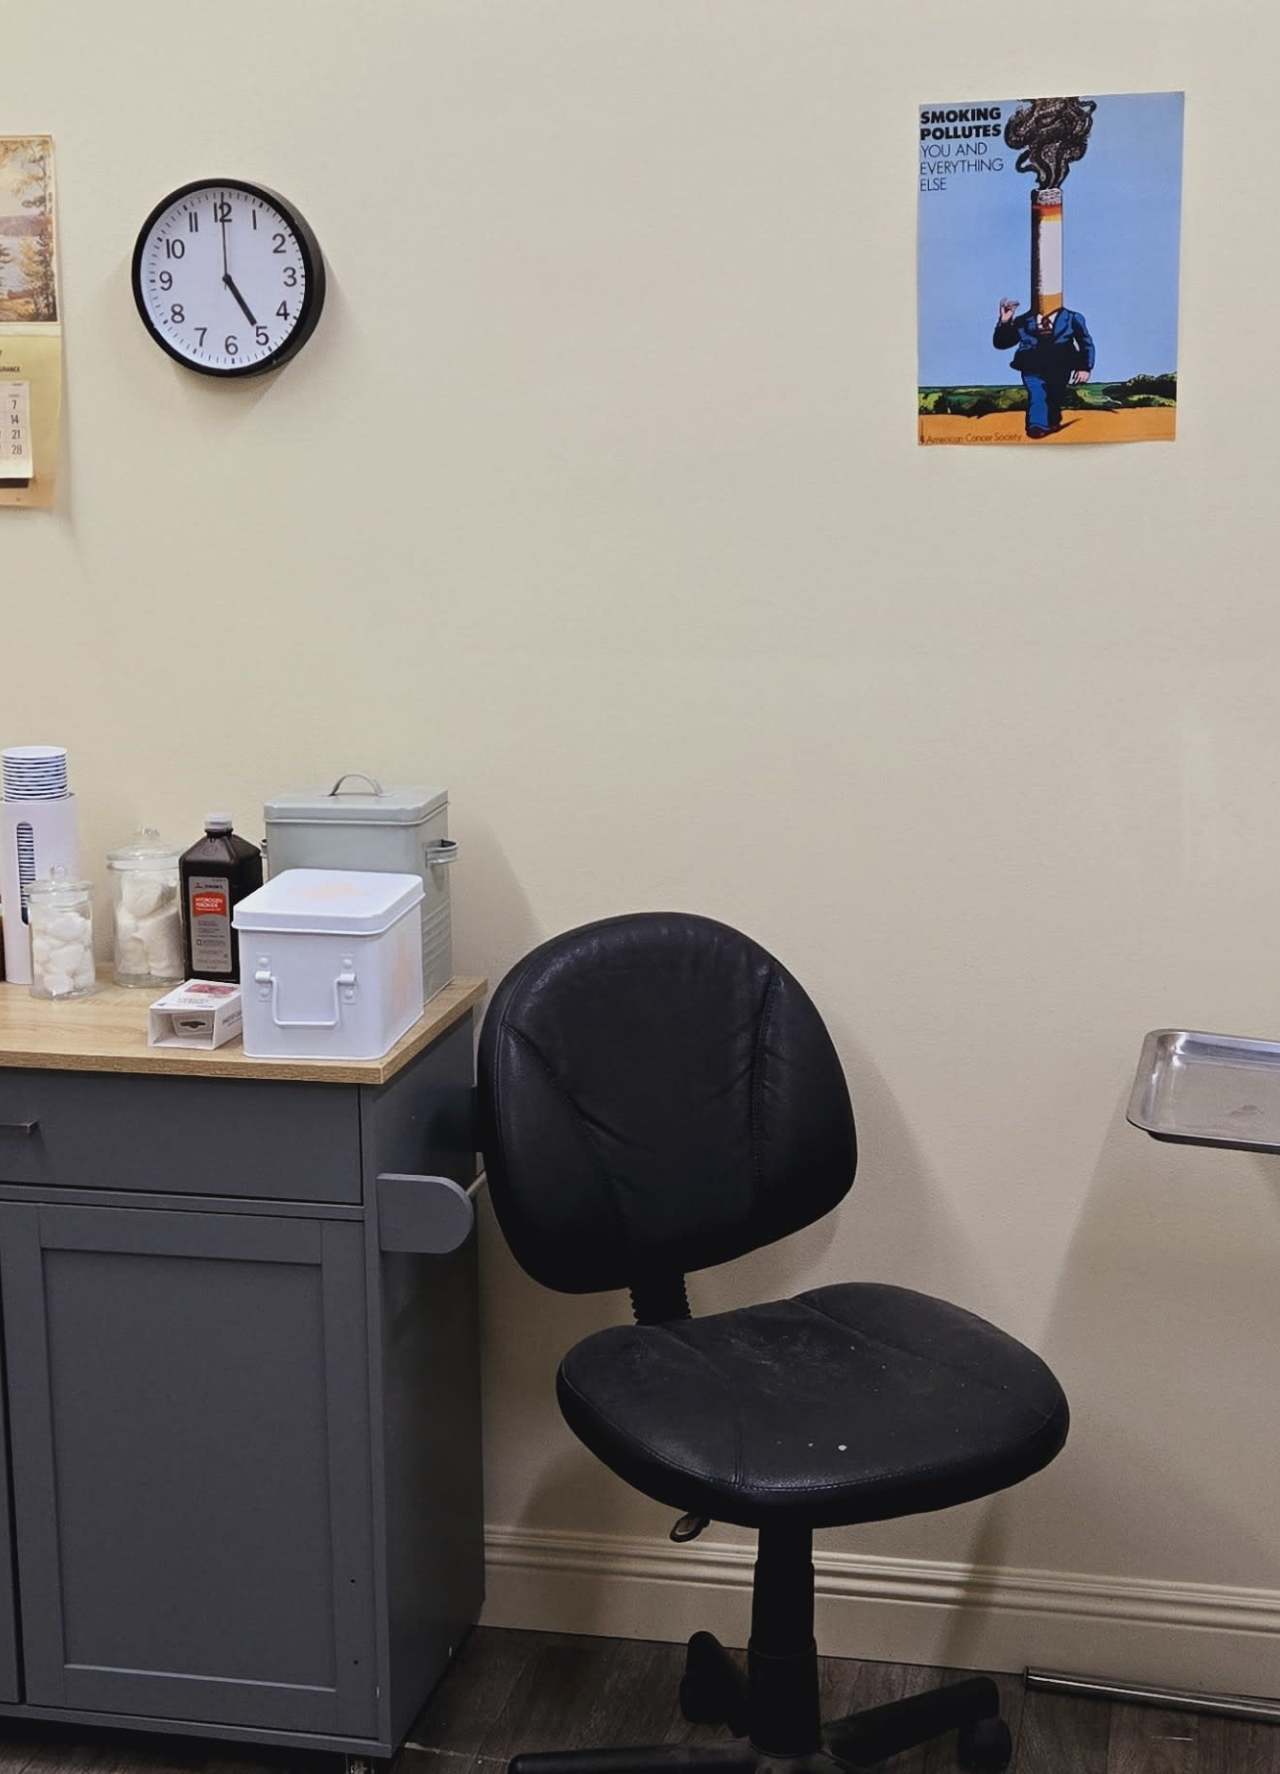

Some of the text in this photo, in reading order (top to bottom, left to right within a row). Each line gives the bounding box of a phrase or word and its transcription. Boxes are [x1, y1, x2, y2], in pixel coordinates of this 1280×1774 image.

[920, 107, 1002, 124] SMOKING
[920, 124, 1002, 140] POLLUTES
[920, 142, 988, 158] YOU AND
[920, 157, 1005, 175] EVERYTHING
[920, 177, 947, 192] ELSE
[188, 211, 199, 233] 11
[213, 201, 233, 223] 12
[251, 209, 257, 230] 1
[165, 238, 185, 259] 10
[272, 233, 286, 254] 2
[159, 270, 173, 291] 9
[283, 266, 297, 287] 3
[170, 303, 185, 324] 8
[275, 300, 290, 321] 4
[194, 327, 208, 347] 7
[224, 335, 238, 356] 6
[255, 326, 269, 346] 5
[11, 400, 17, 409] 7
[10, 414, 19, 424] 14
[11, 428, 20, 439] 21
[11, 443, 22, 454] 28
